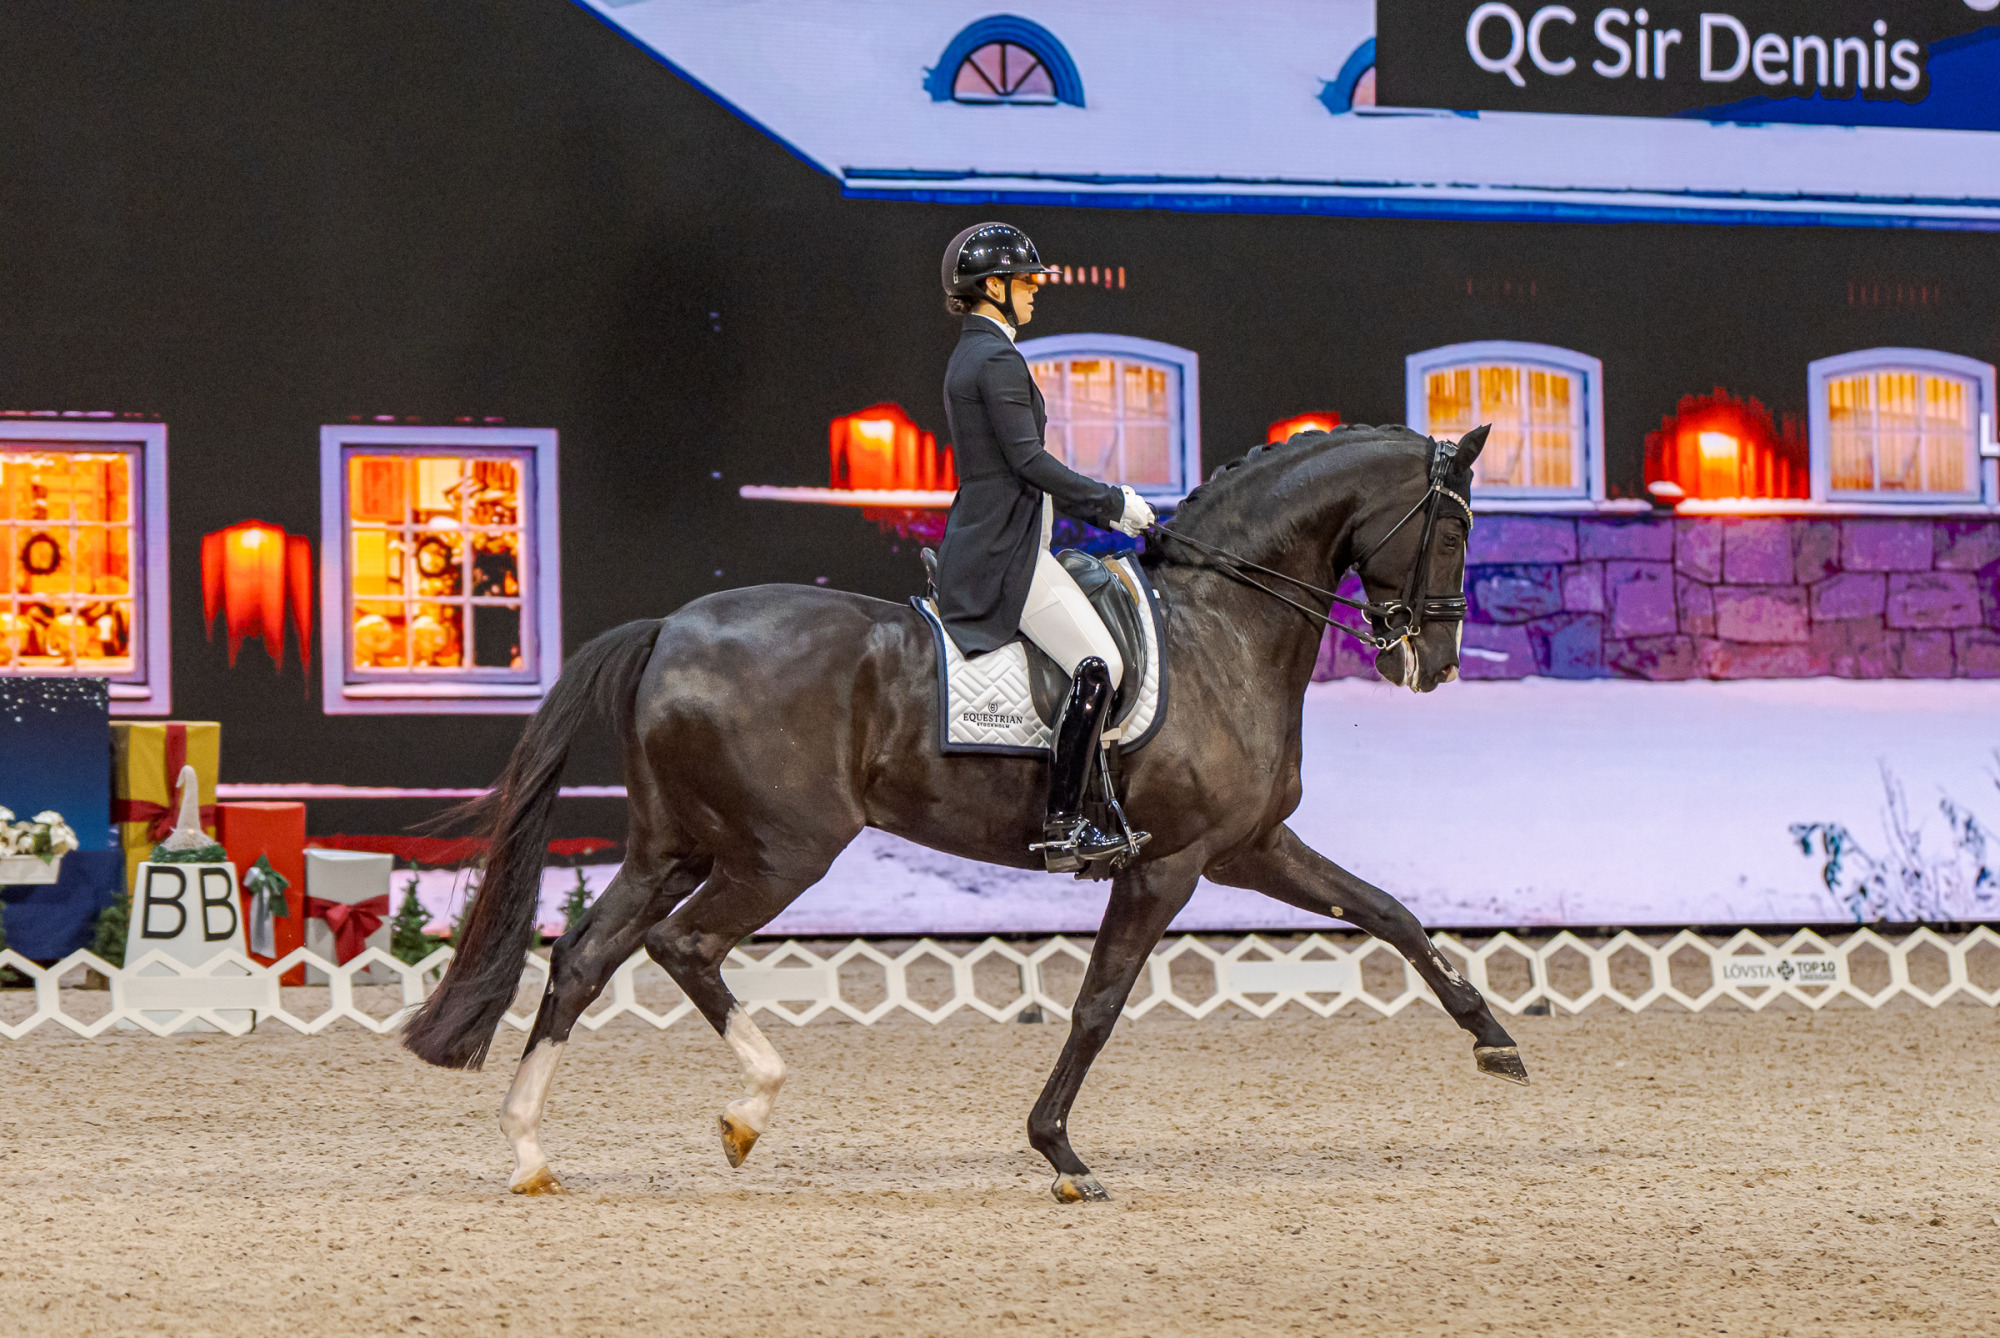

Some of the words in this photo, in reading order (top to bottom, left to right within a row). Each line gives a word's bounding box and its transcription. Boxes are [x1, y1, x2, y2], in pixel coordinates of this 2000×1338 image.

[1466, 2, 1576, 87] QC
[1593, 8, 1682, 79] Sir
[1700, 13, 1920, 91] Dennis
[963, 713, 1023, 724] EQUESTRIAN
[1723, 962, 1775, 979] LÖVSTA
